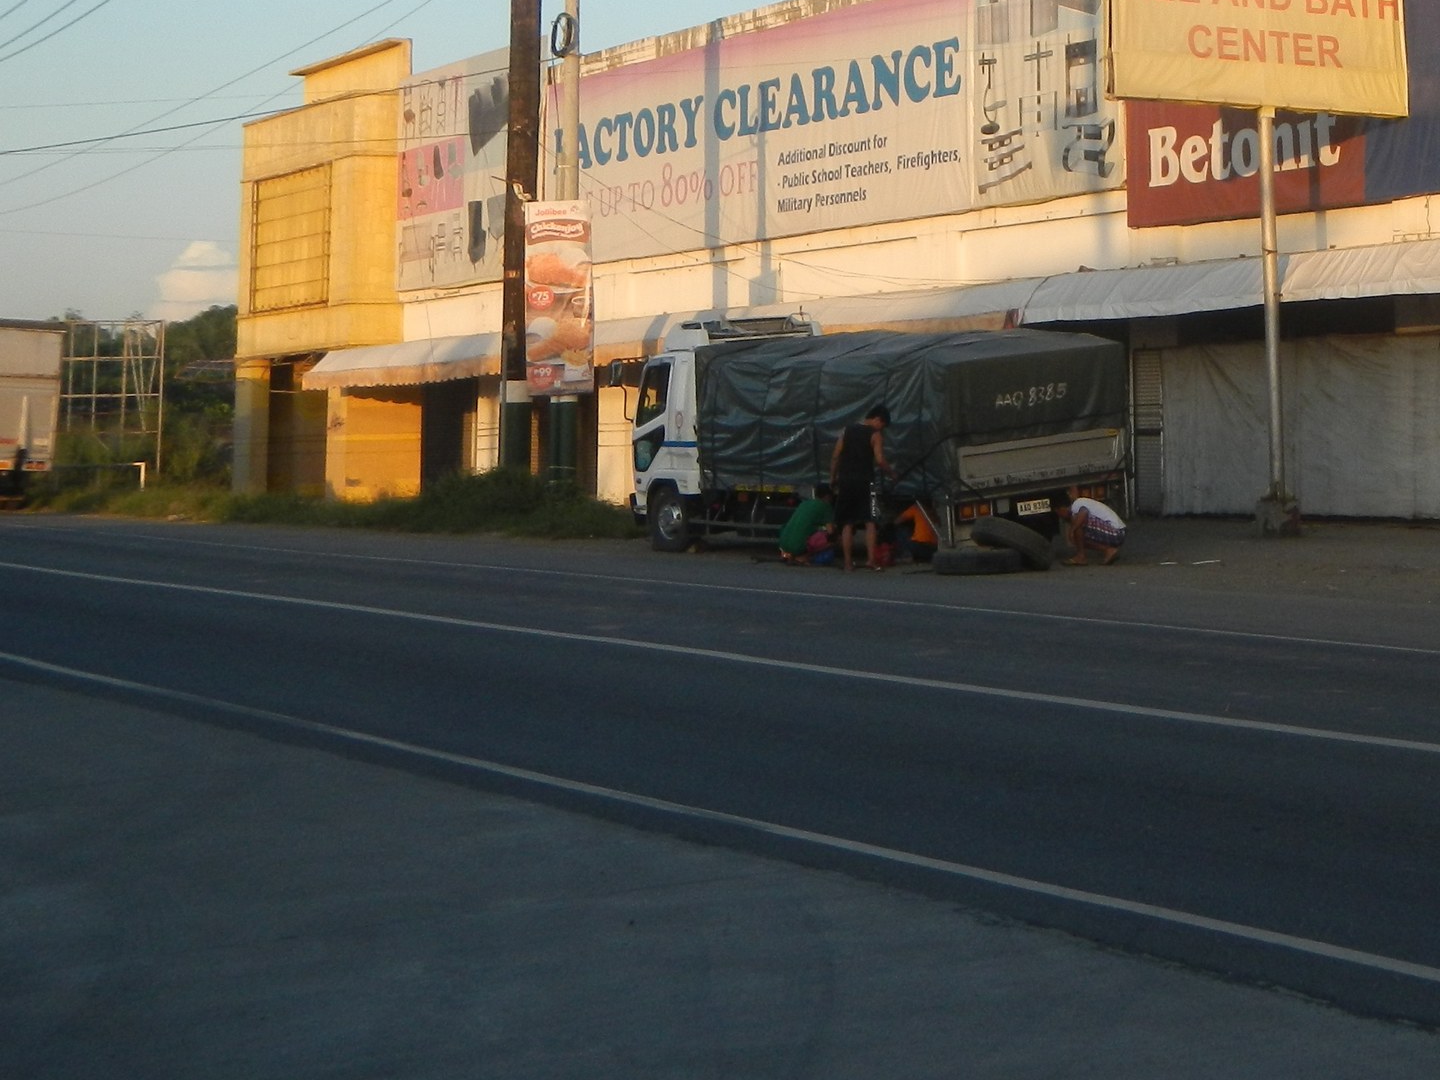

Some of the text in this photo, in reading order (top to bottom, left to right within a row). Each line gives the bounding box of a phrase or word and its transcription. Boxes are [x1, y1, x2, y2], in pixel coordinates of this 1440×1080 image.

[1188, 24, 1343, 69] CENTER
[713, 37, 962, 141] CLEARANCE
[777, 134, 888, 166] Additional Discount for
[782, 172, 810, 189] Public
[811, 166, 842, 184] School
[845, 160, 892, 179] Teachers,
[896, 149, 962, 170] Firefighters,
[600, 186, 623, 218] UP
[628, 179, 655, 212] TO
[661, 162, 713, 207] 80%
[719, 161, 759, 196] OFF
[777, 187, 867, 213] Military Personnels
[535, 208, 567, 217] Jollibee
[1028, 382, 1067, 407] 8385
